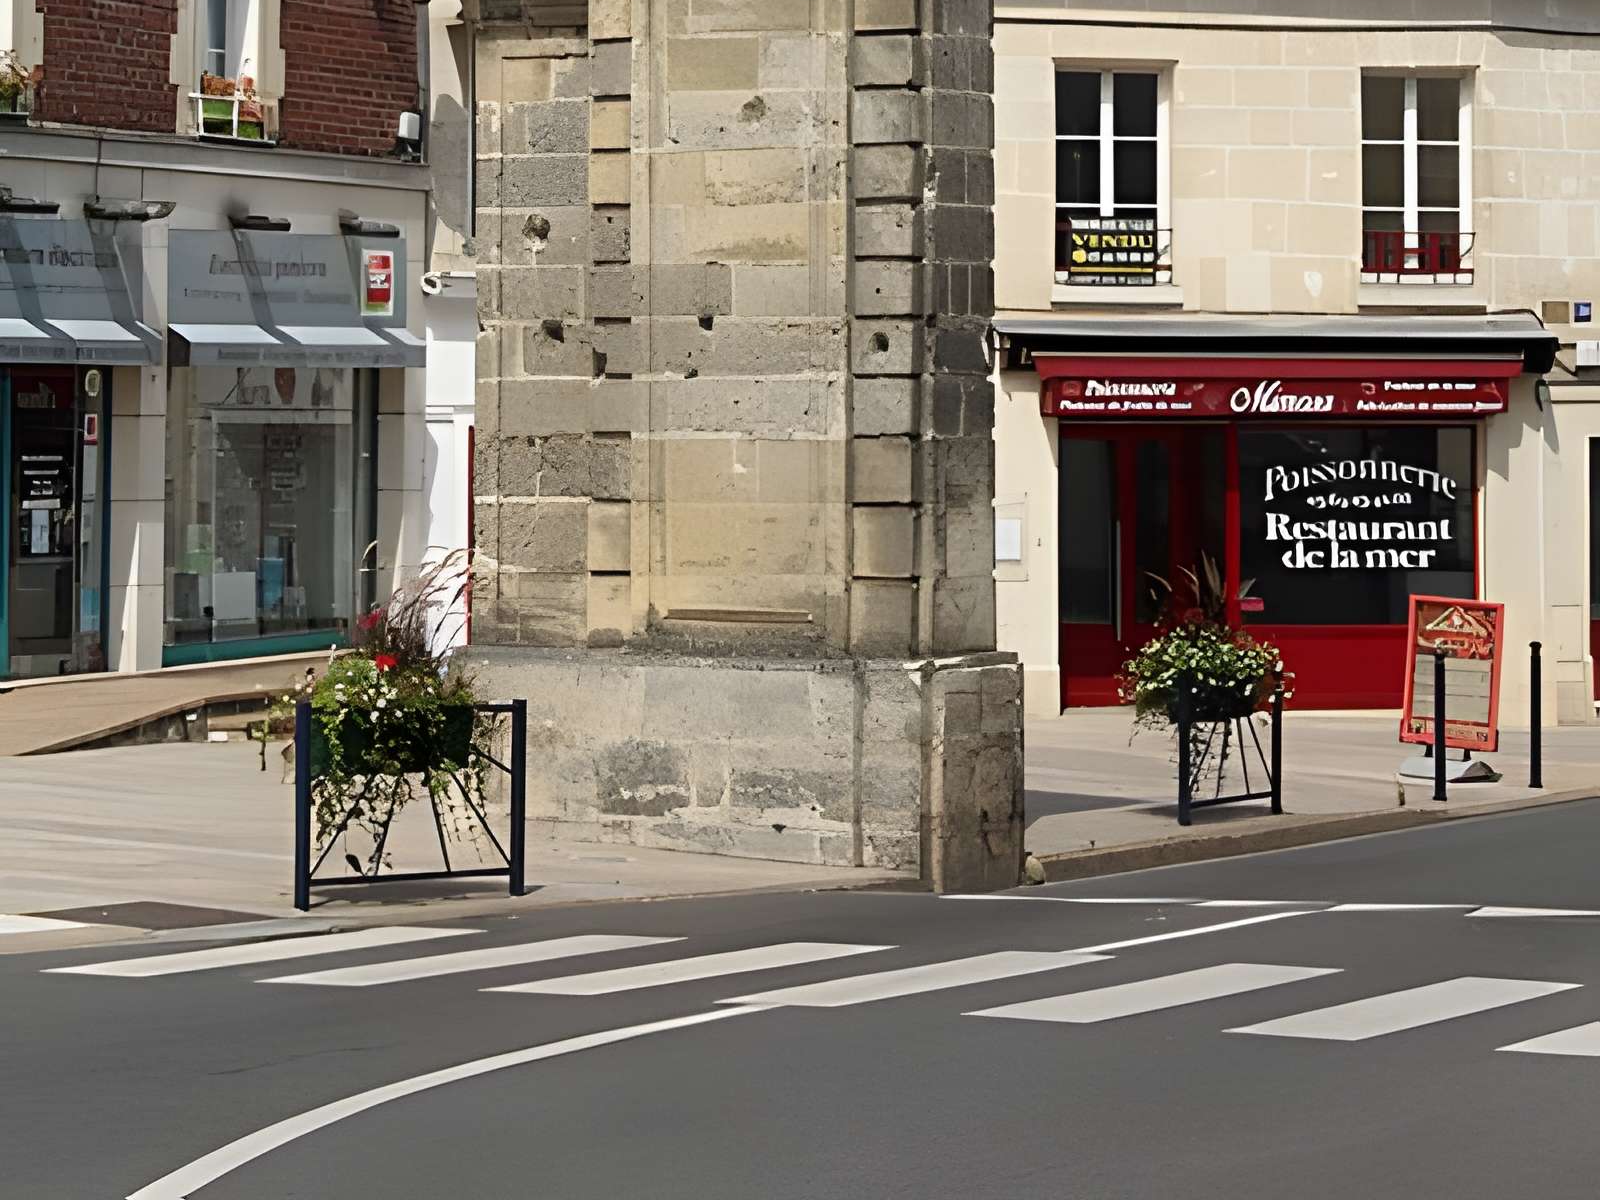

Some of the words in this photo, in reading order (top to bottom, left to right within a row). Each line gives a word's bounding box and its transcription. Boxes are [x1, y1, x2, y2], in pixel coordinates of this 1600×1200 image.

[1265, 512, 1454, 540] Restaurant
[1281, 540, 1325, 569] de
[1330, 539, 1360, 568] la
[1365, 548, 1437, 568] mer
